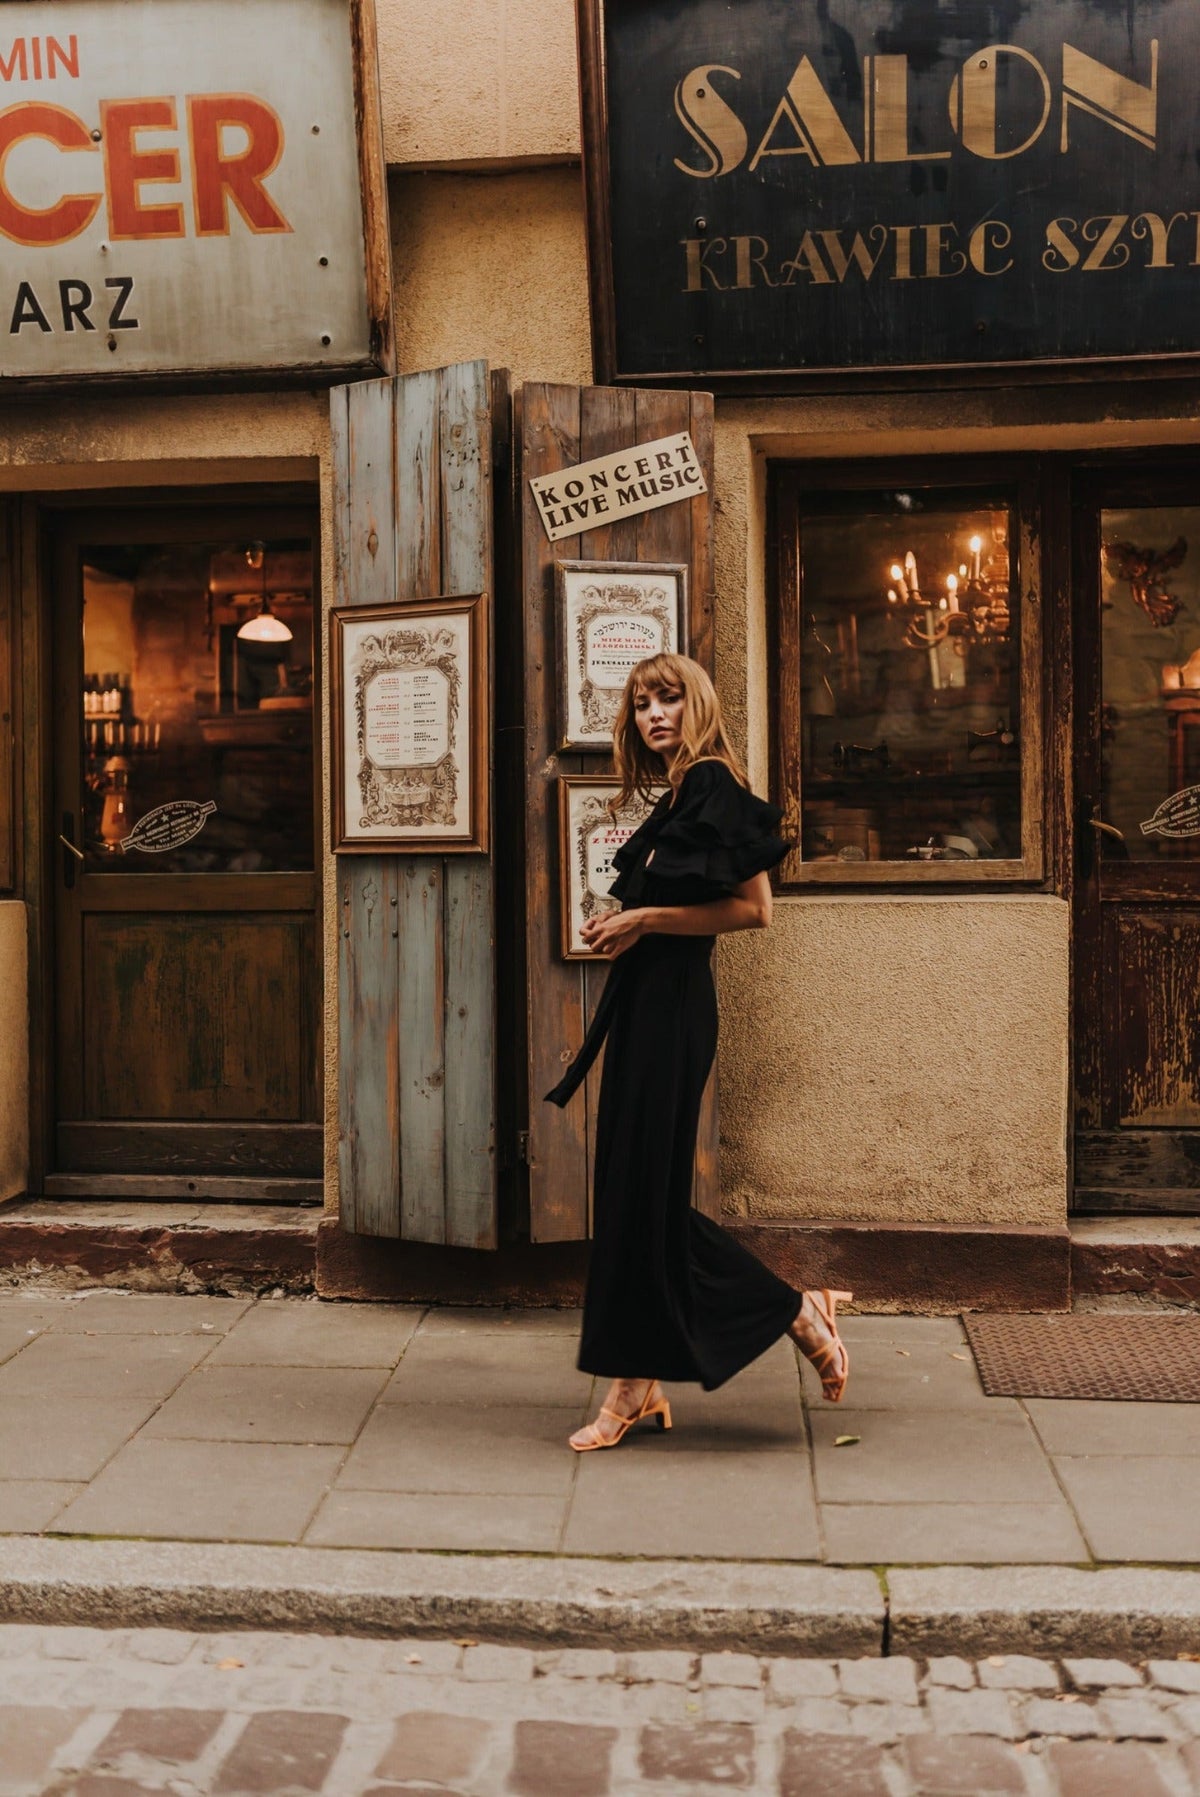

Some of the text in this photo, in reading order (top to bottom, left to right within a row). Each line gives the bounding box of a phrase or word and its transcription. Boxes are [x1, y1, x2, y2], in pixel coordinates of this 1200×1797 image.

[674, 39, 1159, 178] SALON
[0, 92, 295, 247] CER
[680, 220, 1014, 293] KRAWIEC
[10, 276, 139, 335] ARZ
[538, 445, 690, 508] KONCERT
[545, 467, 700, 529] LIVE MUSIC
